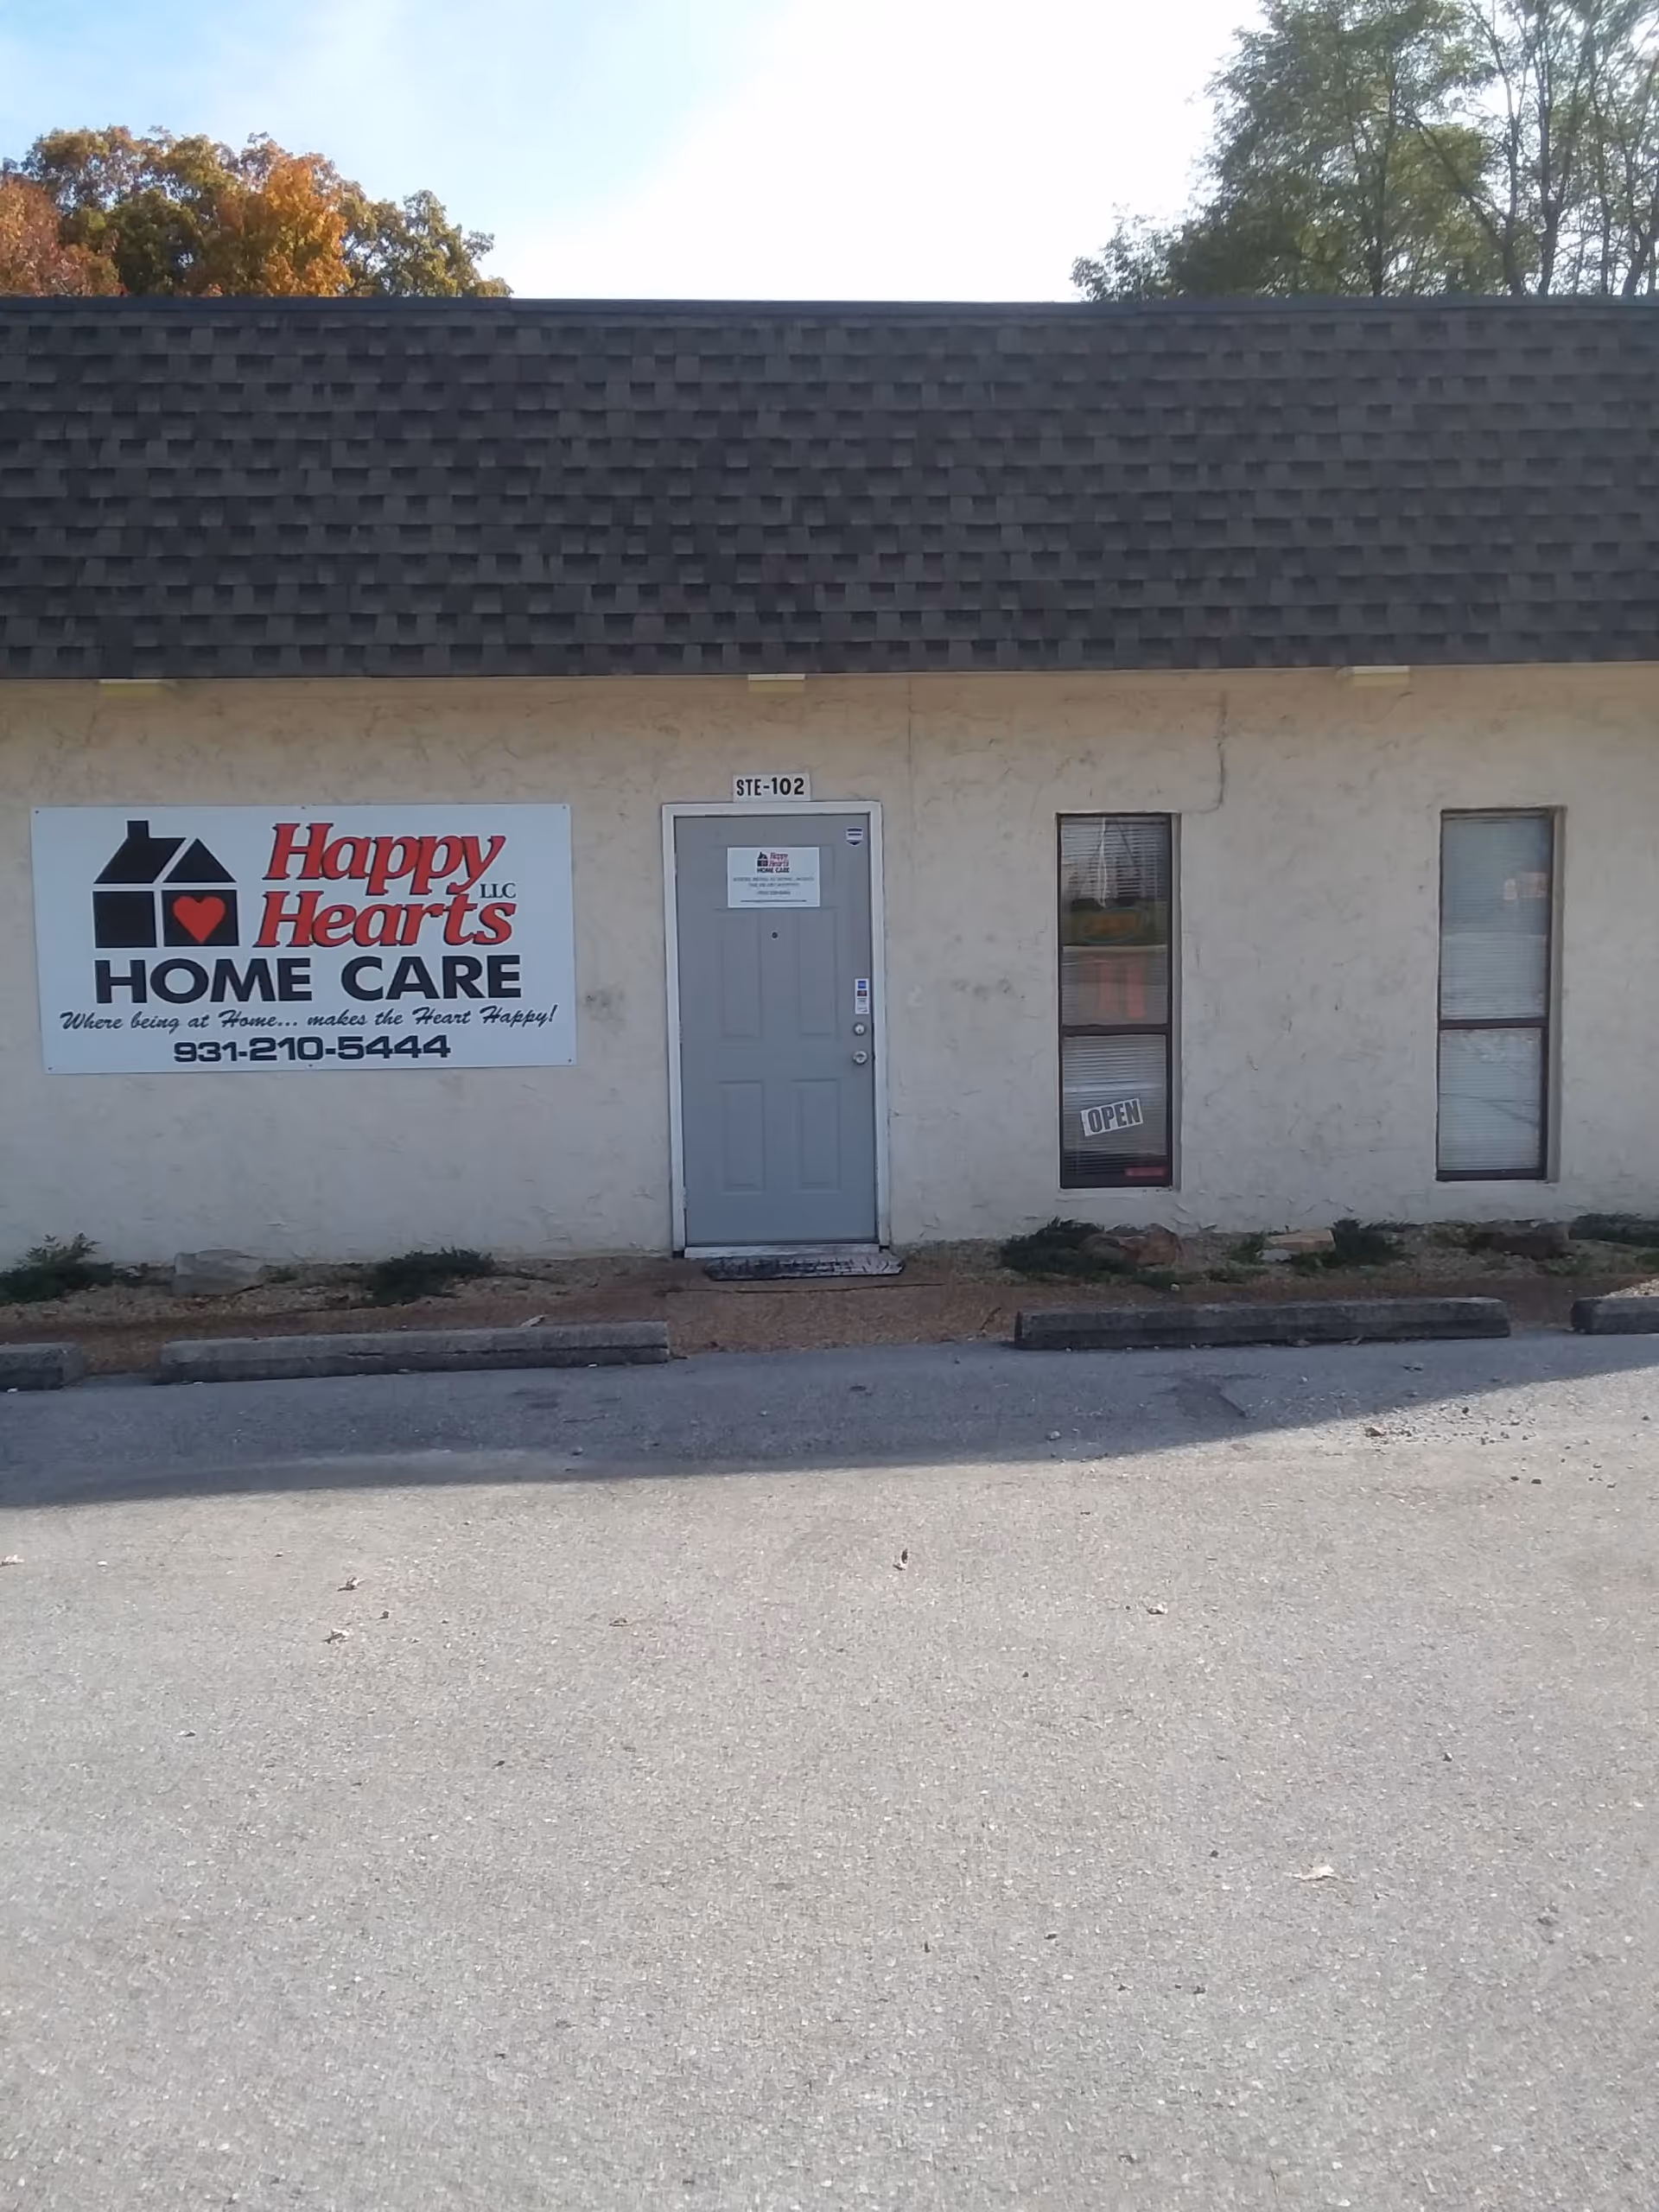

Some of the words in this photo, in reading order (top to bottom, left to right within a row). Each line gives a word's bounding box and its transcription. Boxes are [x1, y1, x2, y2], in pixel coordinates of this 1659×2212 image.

[736, 777, 804, 796] STE-102
[262, 823, 506, 895] Happy
[479, 883, 517, 899] LLC
[252, 891, 517, 947] Hearts
[94, 957, 312, 1004] HOME
[340, 955, 522, 1001] CARE
[59, 1011, 123, 1029] Where
[130, 1011, 180, 1035] being
[188, 1014, 210, 1028] at
[218, 1009, 298, 1028] Home...
[308, 1008, 367, 1027] makes
[375, 1008, 403, 1026] the
[412, 1005, 471, 1025] Heart
[480, 1004, 558, 1027] Happy!
[174, 1034, 451, 1063] 931-210-5444
[1088, 1101, 1141, 1133] OPEN
